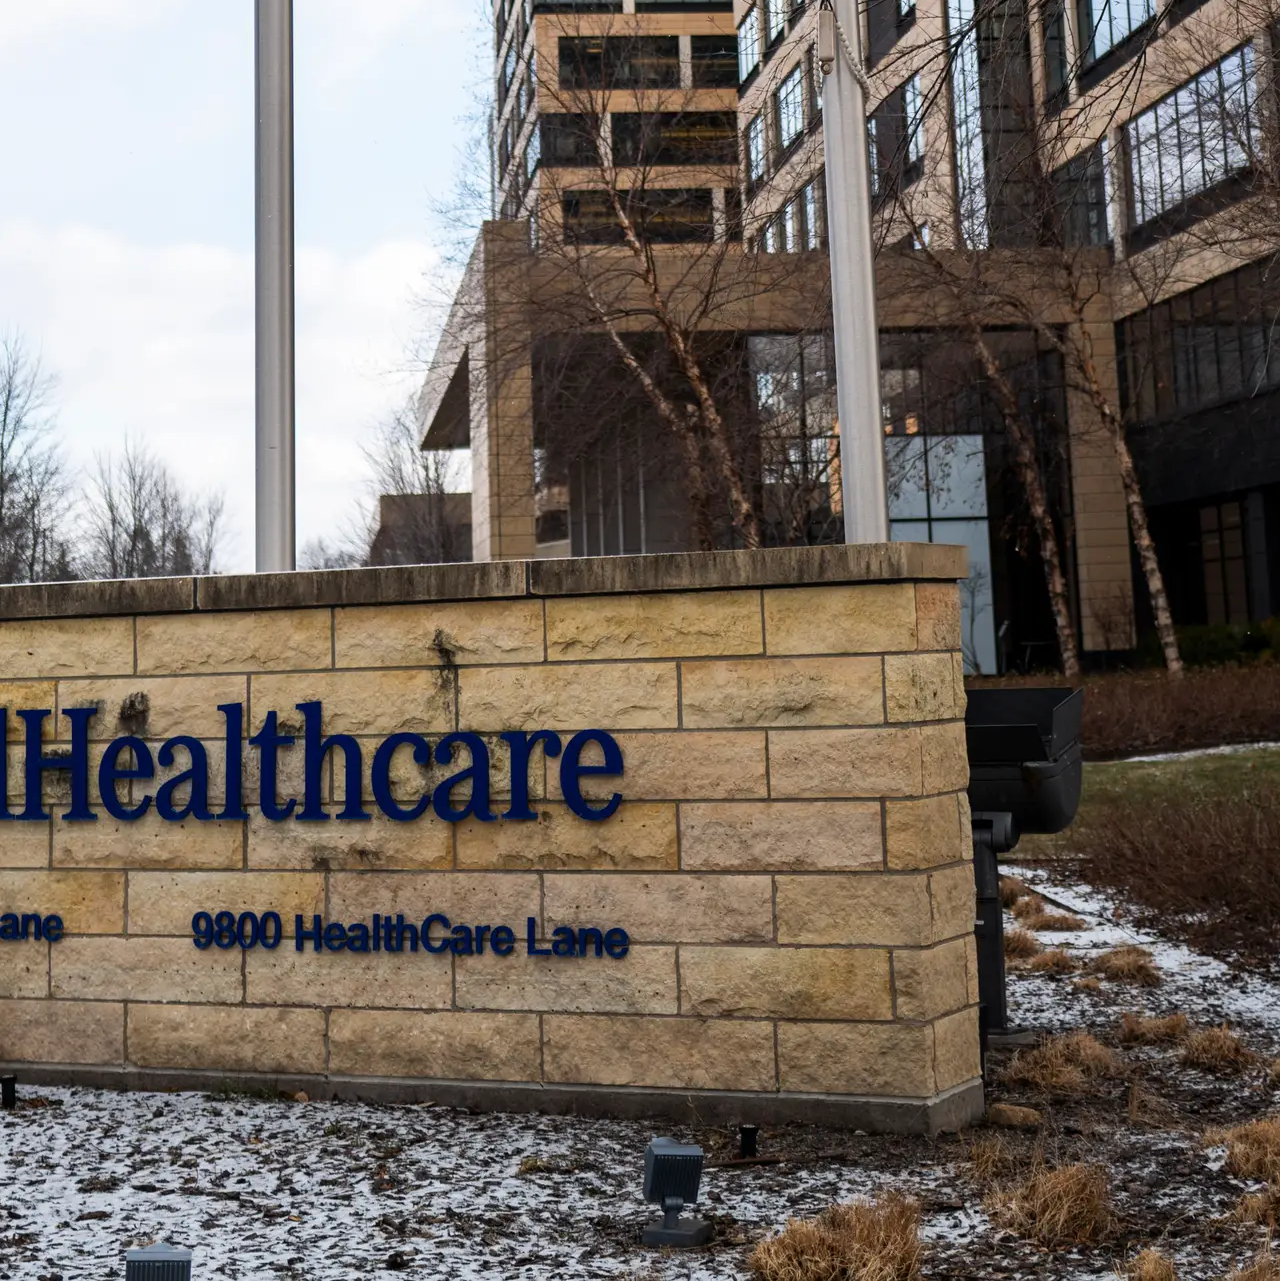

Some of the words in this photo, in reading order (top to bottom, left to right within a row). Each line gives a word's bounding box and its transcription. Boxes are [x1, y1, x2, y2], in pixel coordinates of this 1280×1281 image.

[191, 910, 282, 951] 9800
[295, 913, 515, 957] HealthCare
[526, 916, 629, 959] Lane
